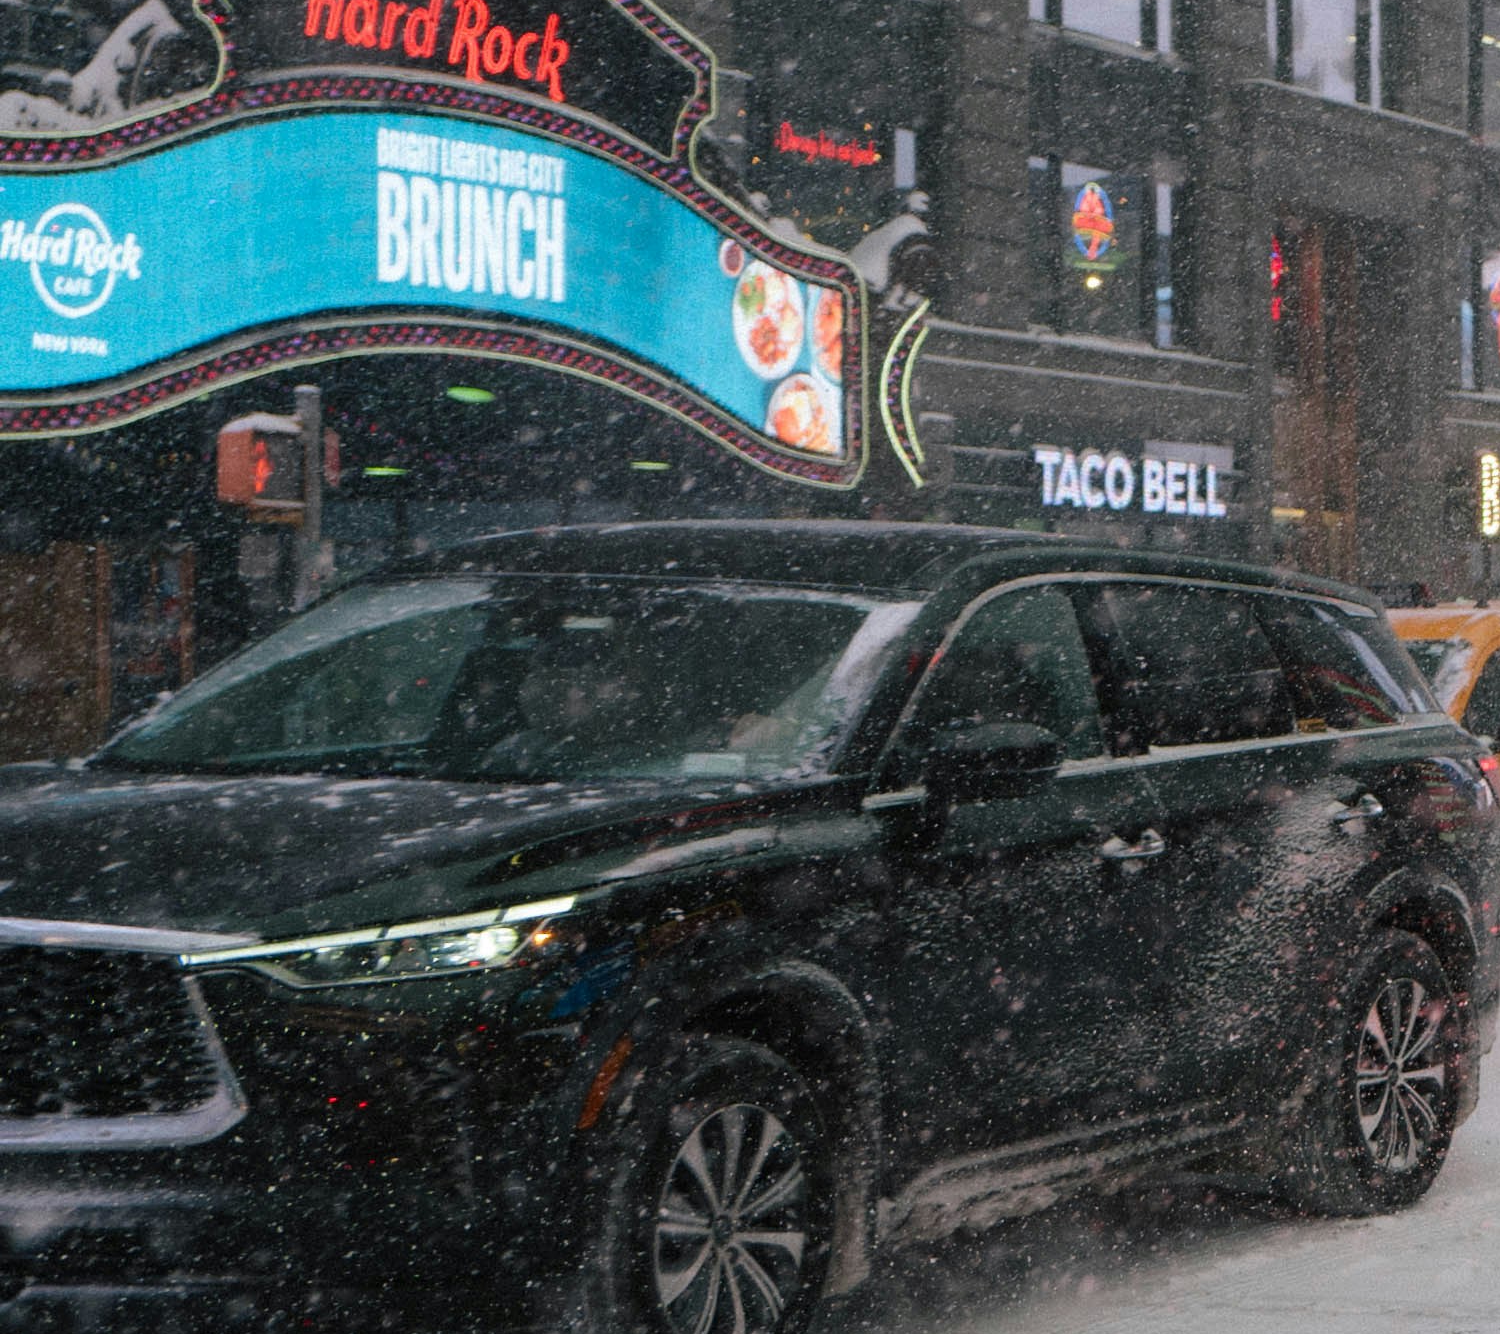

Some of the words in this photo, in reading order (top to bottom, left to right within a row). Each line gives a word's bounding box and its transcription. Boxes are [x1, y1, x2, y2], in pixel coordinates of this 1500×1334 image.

[0, 220, 74, 266] Hard
[73, 228, 143, 280] Rock
[377, 170, 566, 303] BRUNCH
[53, 276, 93, 297] CAFE
[1036, 448, 1133, 506] TACO
[1143, 459, 1226, 516] BELL
